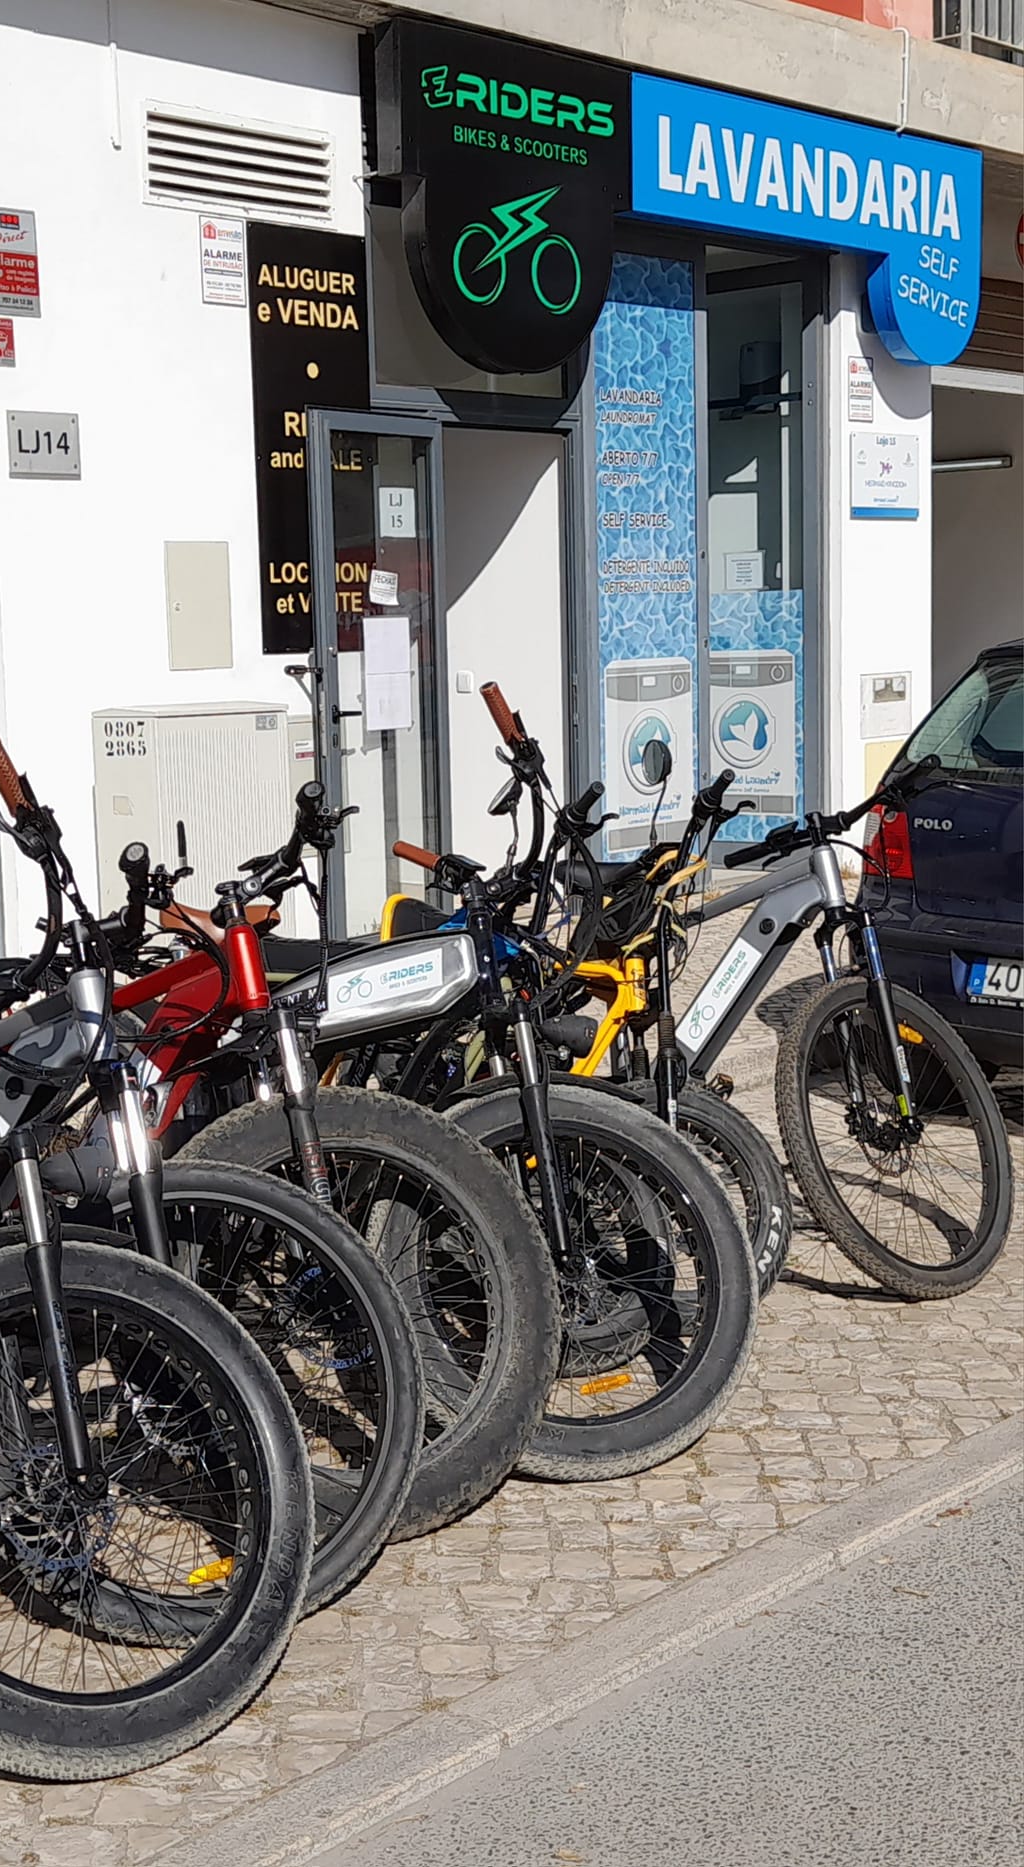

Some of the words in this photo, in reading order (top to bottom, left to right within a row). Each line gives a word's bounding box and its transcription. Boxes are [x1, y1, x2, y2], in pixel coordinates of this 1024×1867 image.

[454, 125, 497, 149] BIKES
[500, 134, 510, 151] &
[514, 136, 588, 166] SCOOTERS
[658, 114, 961, 241] LAVANDARIA
[203, 248, 243, 262] ALARME
[919, 245, 959, 282] SELF
[258, 263, 356, 296] ALUGUER
[897, 274, 970, 329] SERVICE
[257, 302, 272, 323] e
[276, 297, 359, 331] VENDA
[600, 388, 663, 405] LAVANDARIA
[600, 411, 657, 424] LAUNDROMAT
[17, 429, 71, 455] LJ14
[270, 451, 304, 470] and
[602, 451, 639, 466] ABERTO
[641, 452, 658, 468] 7/7
[602, 473, 624, 486] OPEN
[389, 493, 403, 508] LJ
[390, 515, 403, 528] 15
[603, 513, 625, 528] SELF
[629, 512, 669, 529] SERVICE
[269, 561, 367, 584] LOCION
[603, 559, 651, 575] DETERGENTE
[604, 581, 650, 594] DETERGENT
[276, 595, 294, 614] et
[104, 721, 145, 738] 0807
[105, 740, 147, 757] 2865
[913, 817, 953, 832] POLO
[987, 962, 1022, 993] 40
[757, 1205, 783, 1274] KEN
